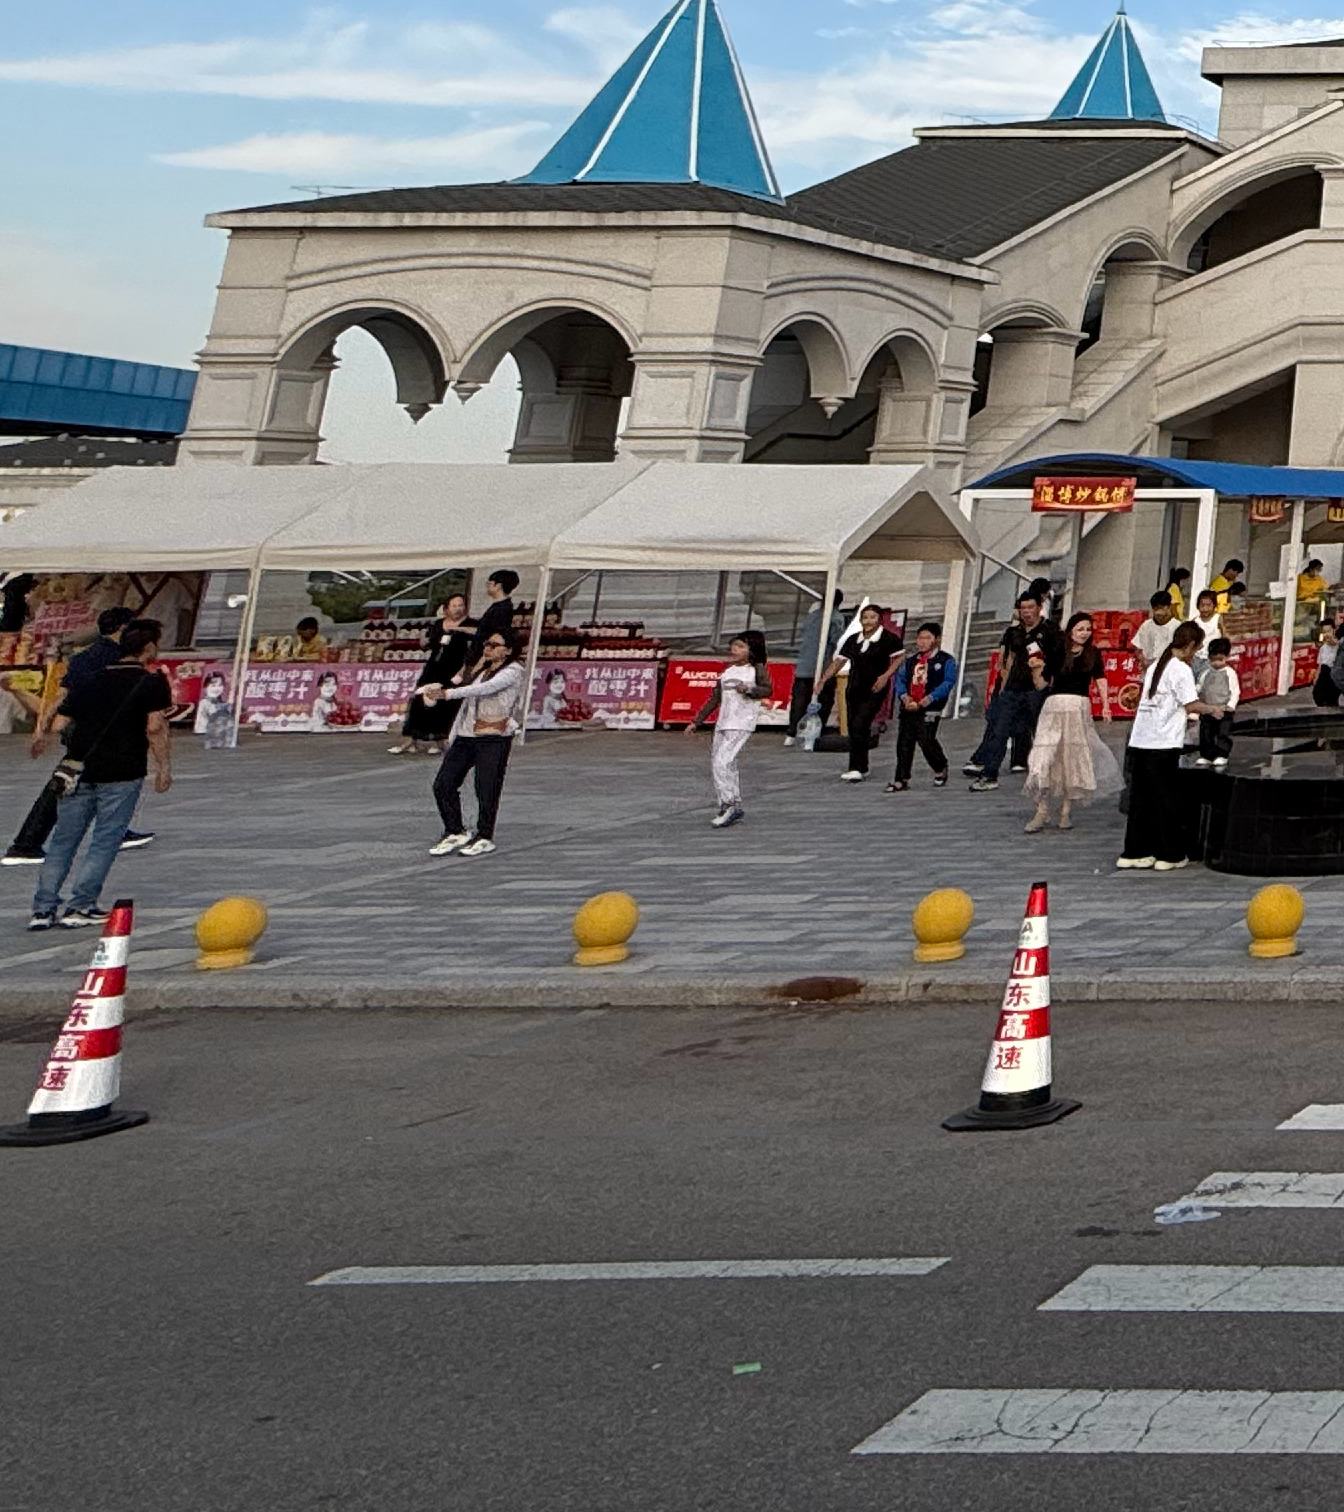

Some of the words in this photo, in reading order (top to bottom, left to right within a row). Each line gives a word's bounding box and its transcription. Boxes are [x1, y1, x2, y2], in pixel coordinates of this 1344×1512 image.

[357, 668, 421, 682] 我从山中
[41, 972, 105, 1092] 山东高速
[994, 951, 1038, 1070] 山东高速
